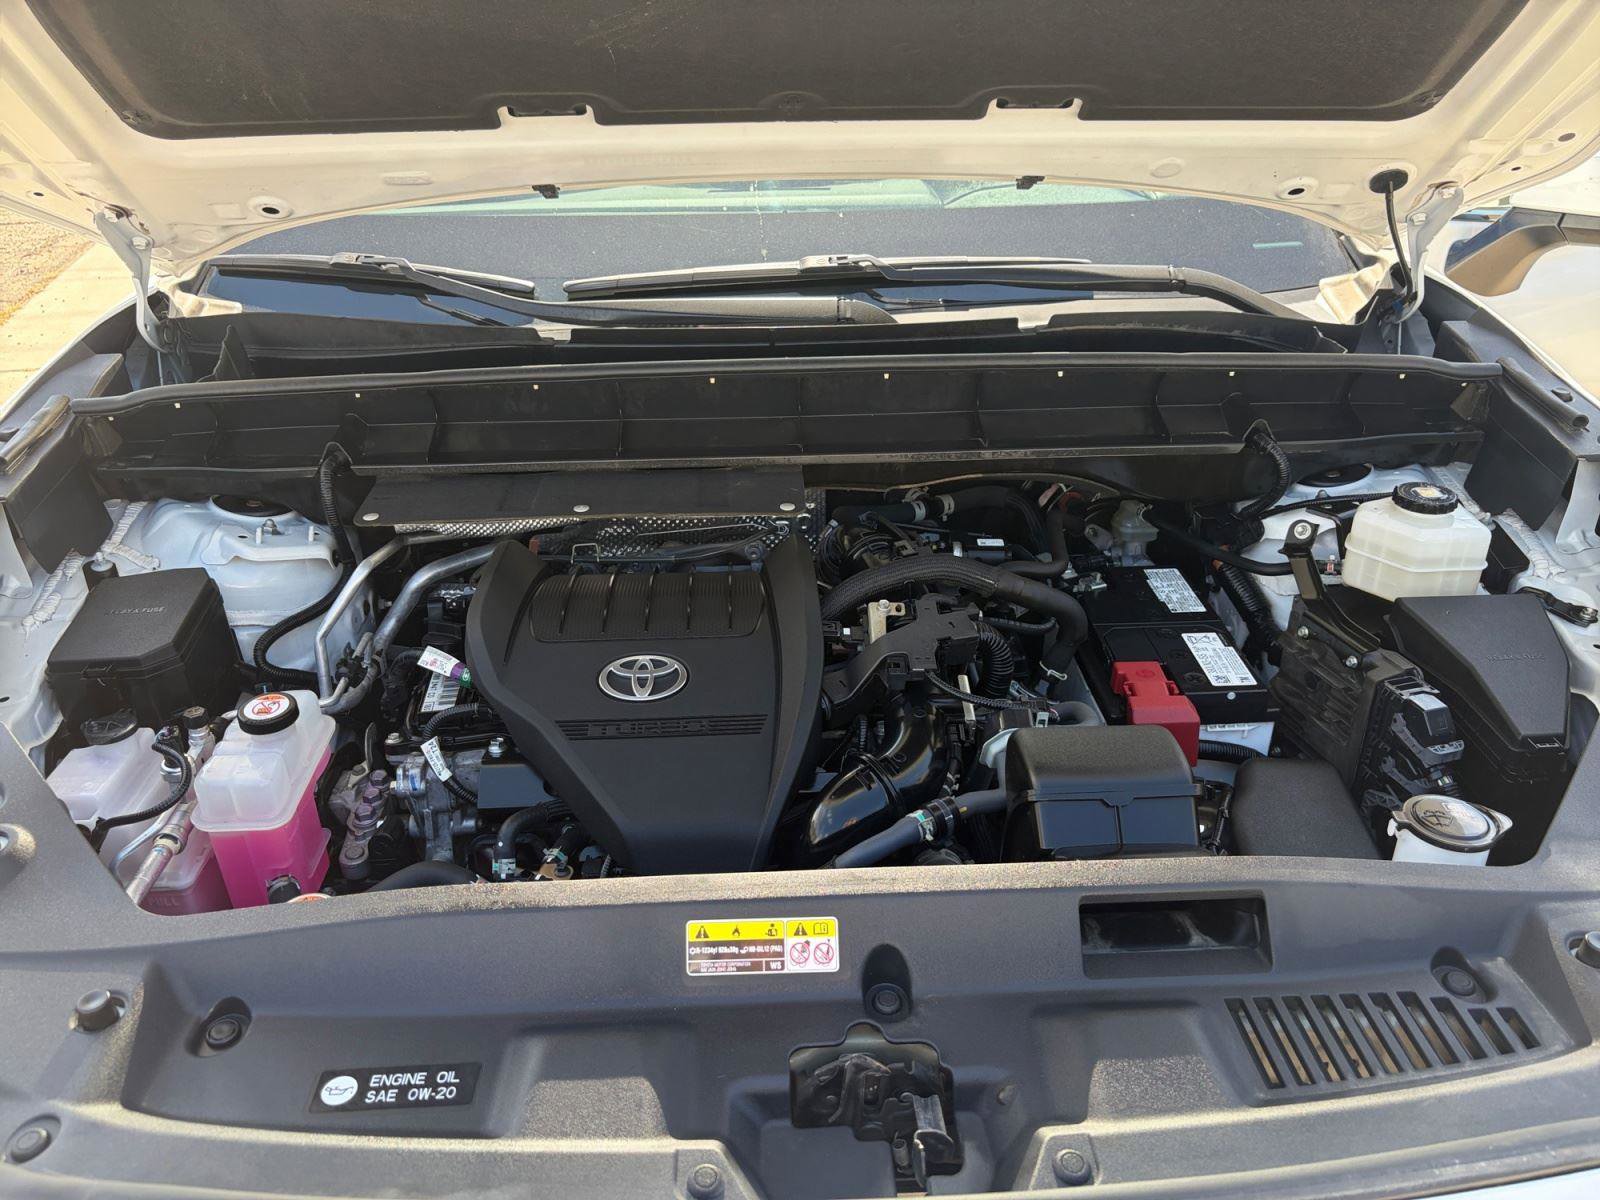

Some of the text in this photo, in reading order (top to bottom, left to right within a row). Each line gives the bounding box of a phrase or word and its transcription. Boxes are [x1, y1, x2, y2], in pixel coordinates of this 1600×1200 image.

[587, 719, 709, 738] TURBO
[770, 961, 782, 970] WS
[369, 1071, 460, 1087] ENGINE OIL
[365, 1086, 457, 1103] SAE 0W-20
